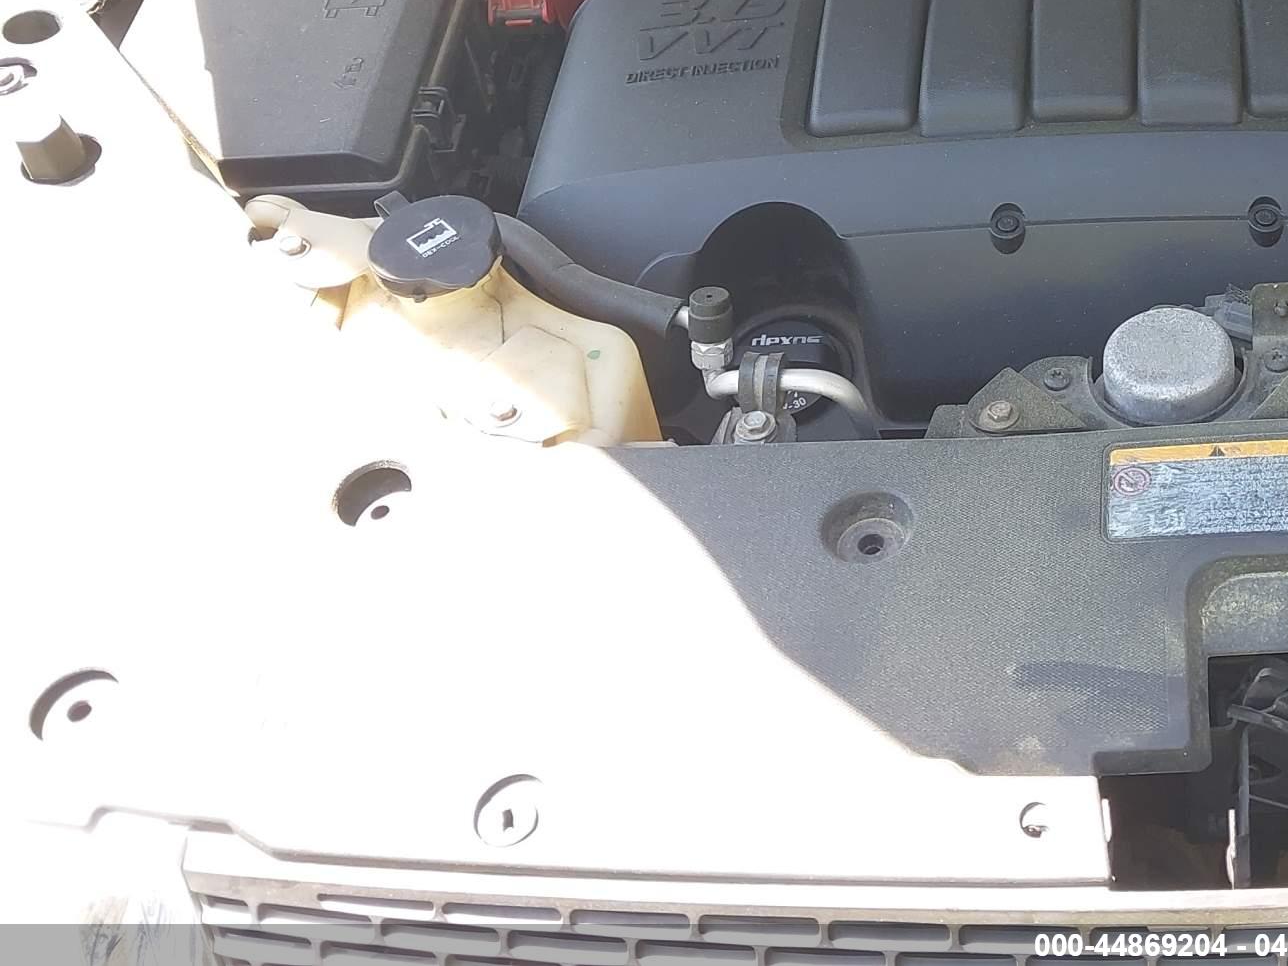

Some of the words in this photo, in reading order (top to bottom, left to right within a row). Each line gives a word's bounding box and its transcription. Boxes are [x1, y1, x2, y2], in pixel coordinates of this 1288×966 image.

[637, 21, 785, 62] VVT
[624, 65, 686, 85] DIRECT
[688, 56, 781, 78] INJECTION
